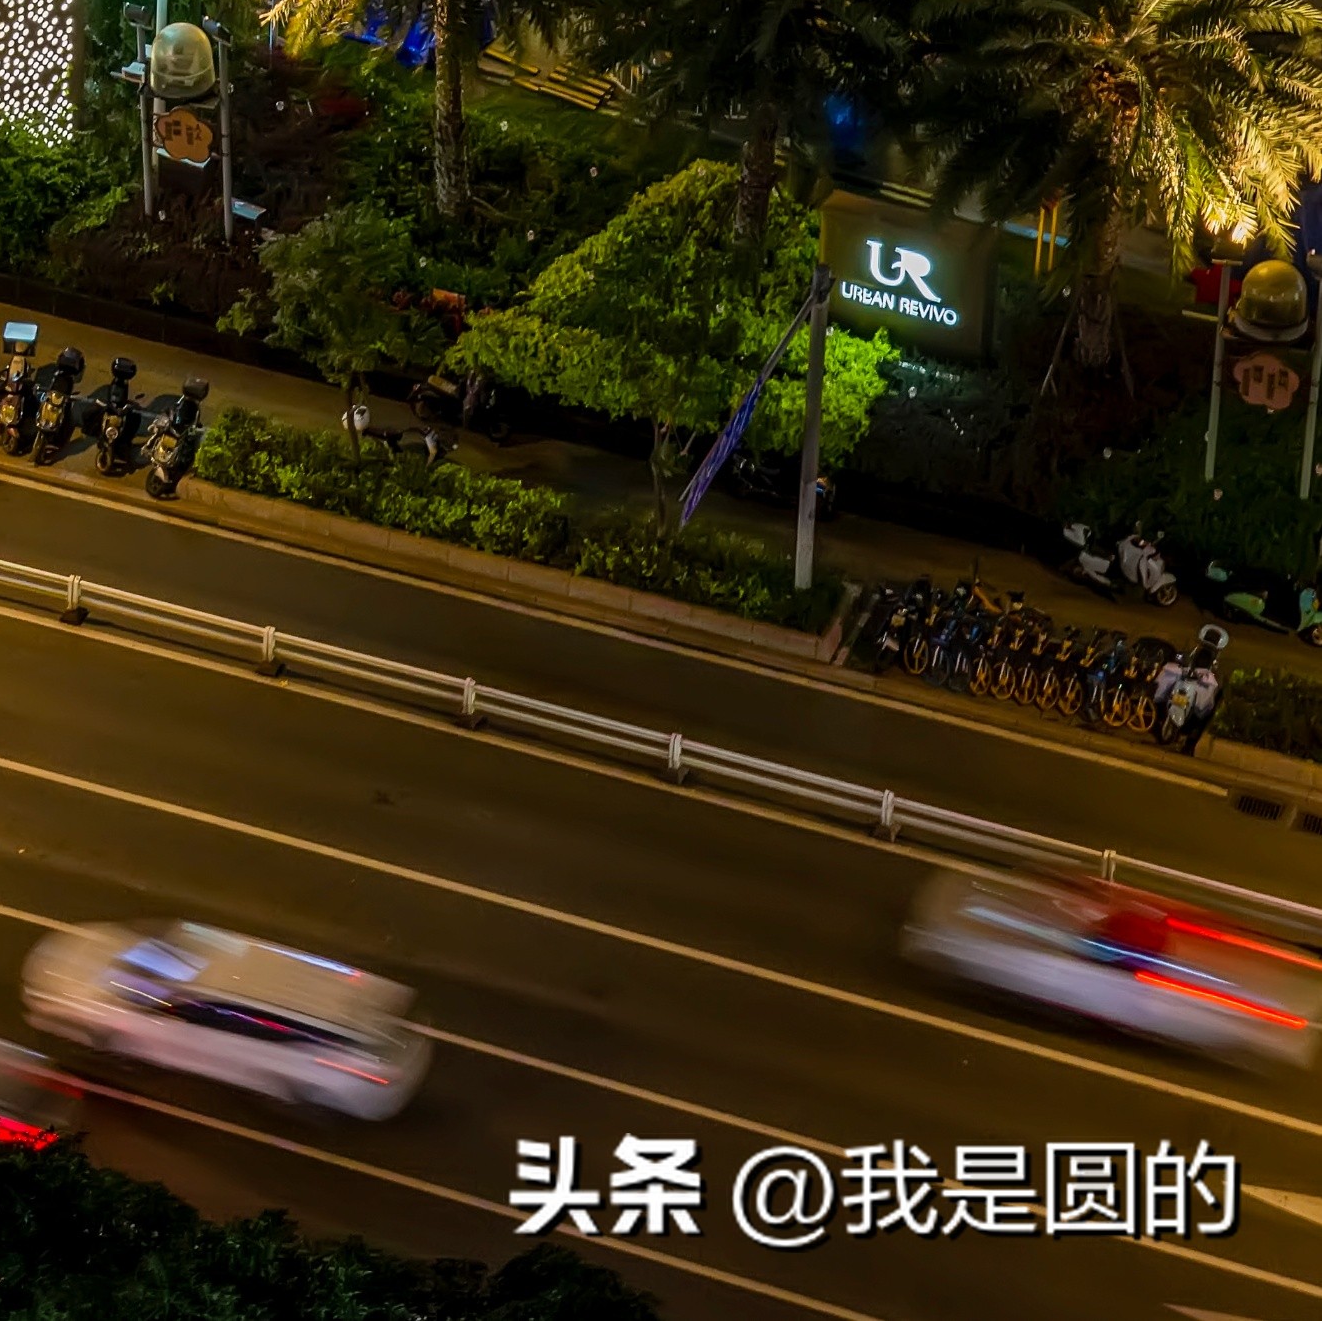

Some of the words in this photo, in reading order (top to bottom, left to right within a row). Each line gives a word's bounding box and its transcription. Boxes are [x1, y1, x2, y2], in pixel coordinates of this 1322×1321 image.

[866, 239, 942, 303] UR
[841, 281, 895, 311] URBAN
[899, 296, 958, 326] REVIVO
